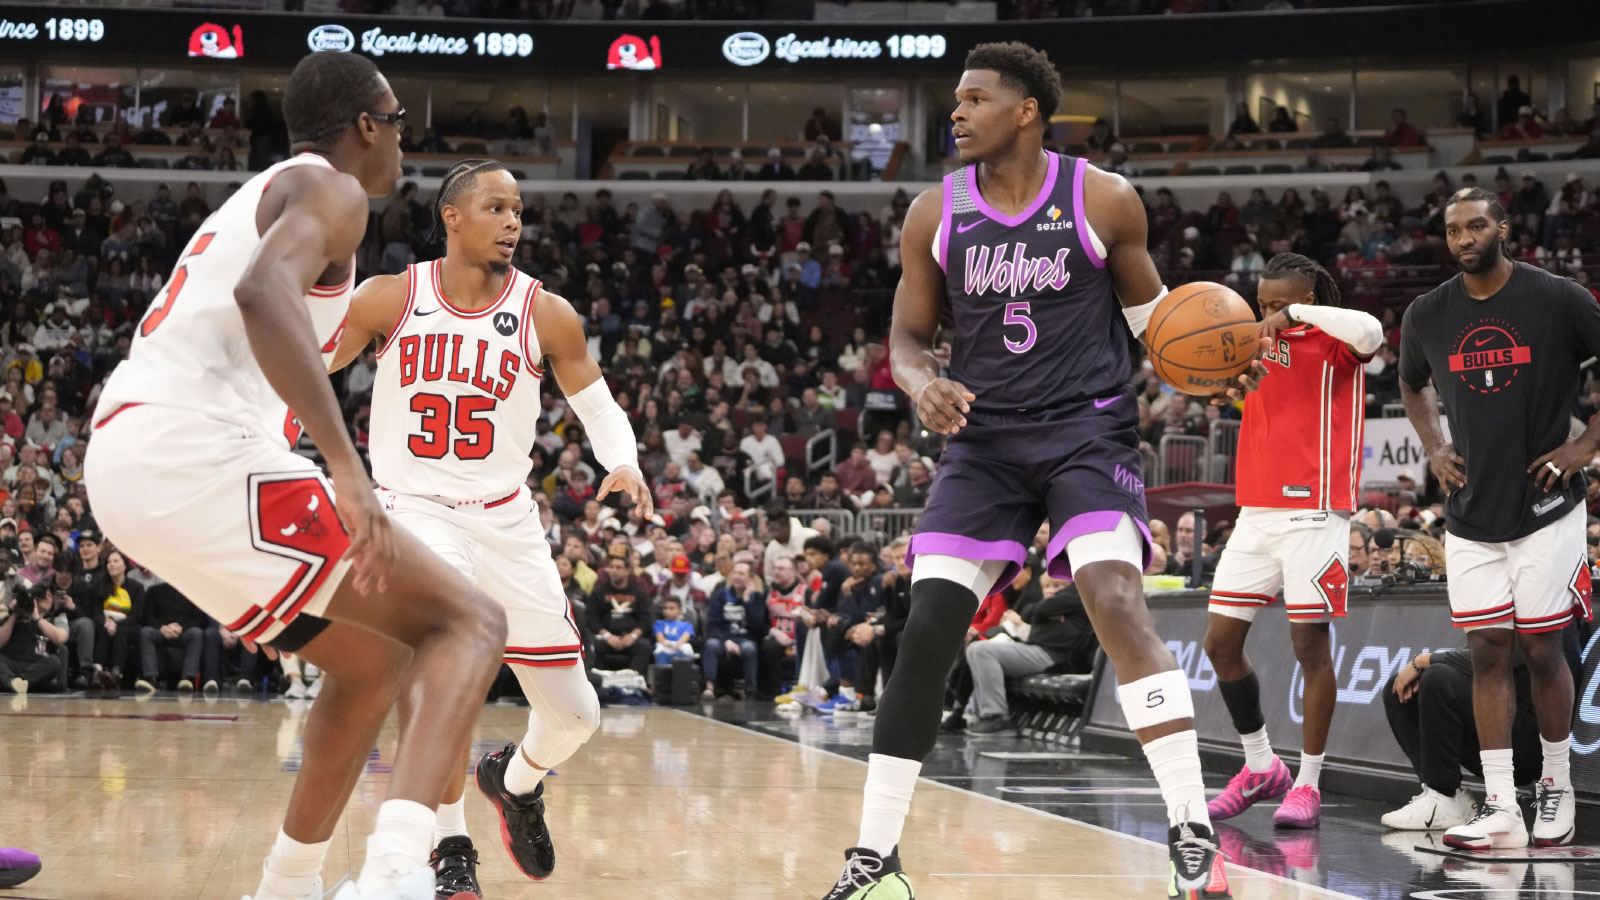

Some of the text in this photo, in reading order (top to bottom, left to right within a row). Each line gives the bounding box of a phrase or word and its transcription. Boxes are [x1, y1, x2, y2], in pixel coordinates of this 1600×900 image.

[0, 18, 104, 41] ince 1899
[361, 27, 533, 56] Local since 1899
[775, 33, 830, 62] Local
[831, 38, 882, 58] since
[886, 34, 946, 58] 1899
[1036, 220, 1073, 231] sezzle
[965, 242, 1071, 298] Wolves
[1003, 301, 1038, 354] 5
[399, 333, 520, 401] BULLS
[1463, 350, 1513, 369] BULLS
[408, 392, 498, 461] 35
[1379, 436, 1427, 466] Adv
[1146, 688, 1164, 709] 5
